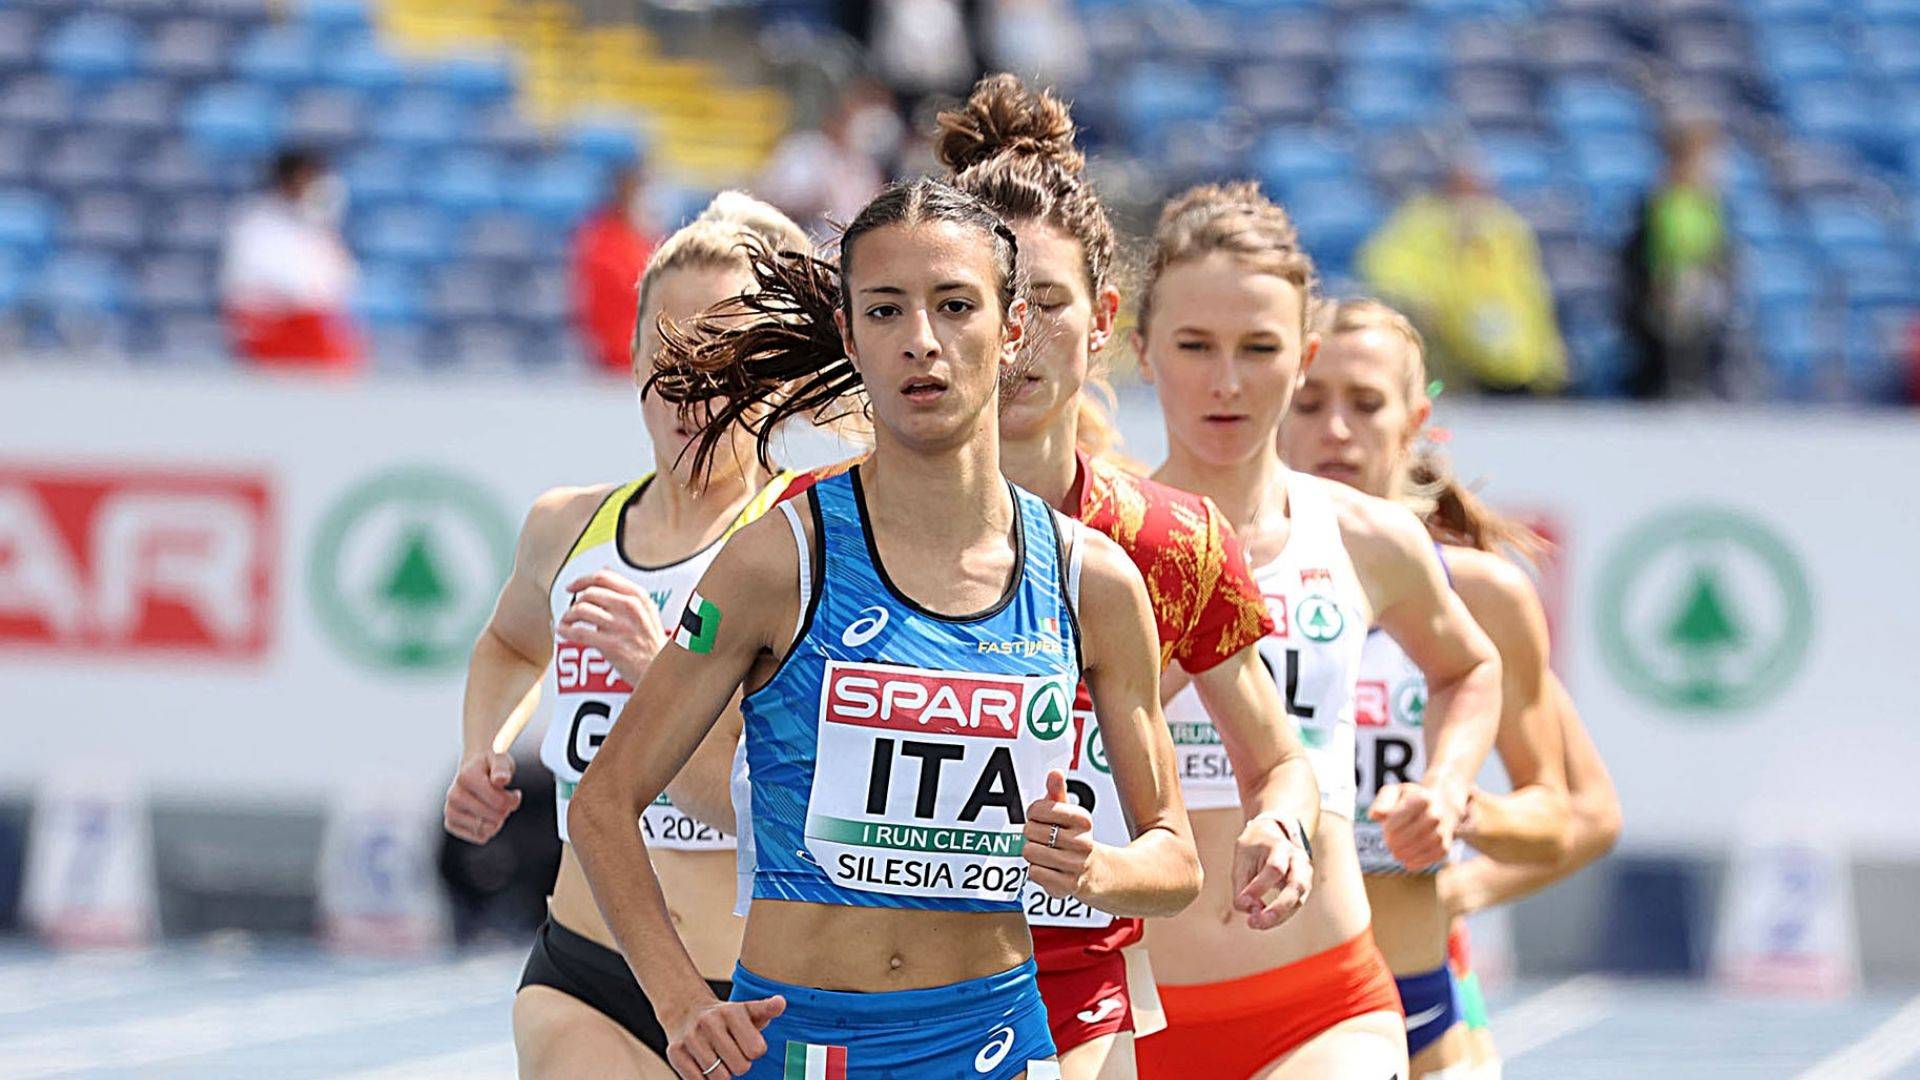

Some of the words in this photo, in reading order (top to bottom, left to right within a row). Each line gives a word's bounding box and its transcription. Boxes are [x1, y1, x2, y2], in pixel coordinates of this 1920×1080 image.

[833, 676, 1017, 731] SPAR
[866, 738, 1025, 825] ITA
[1179, 754, 1234, 778] ESI
[862, 825, 869, 843] I
[876, 826, 928, 849] RUN
[837, 853, 954, 889] SILESIA
